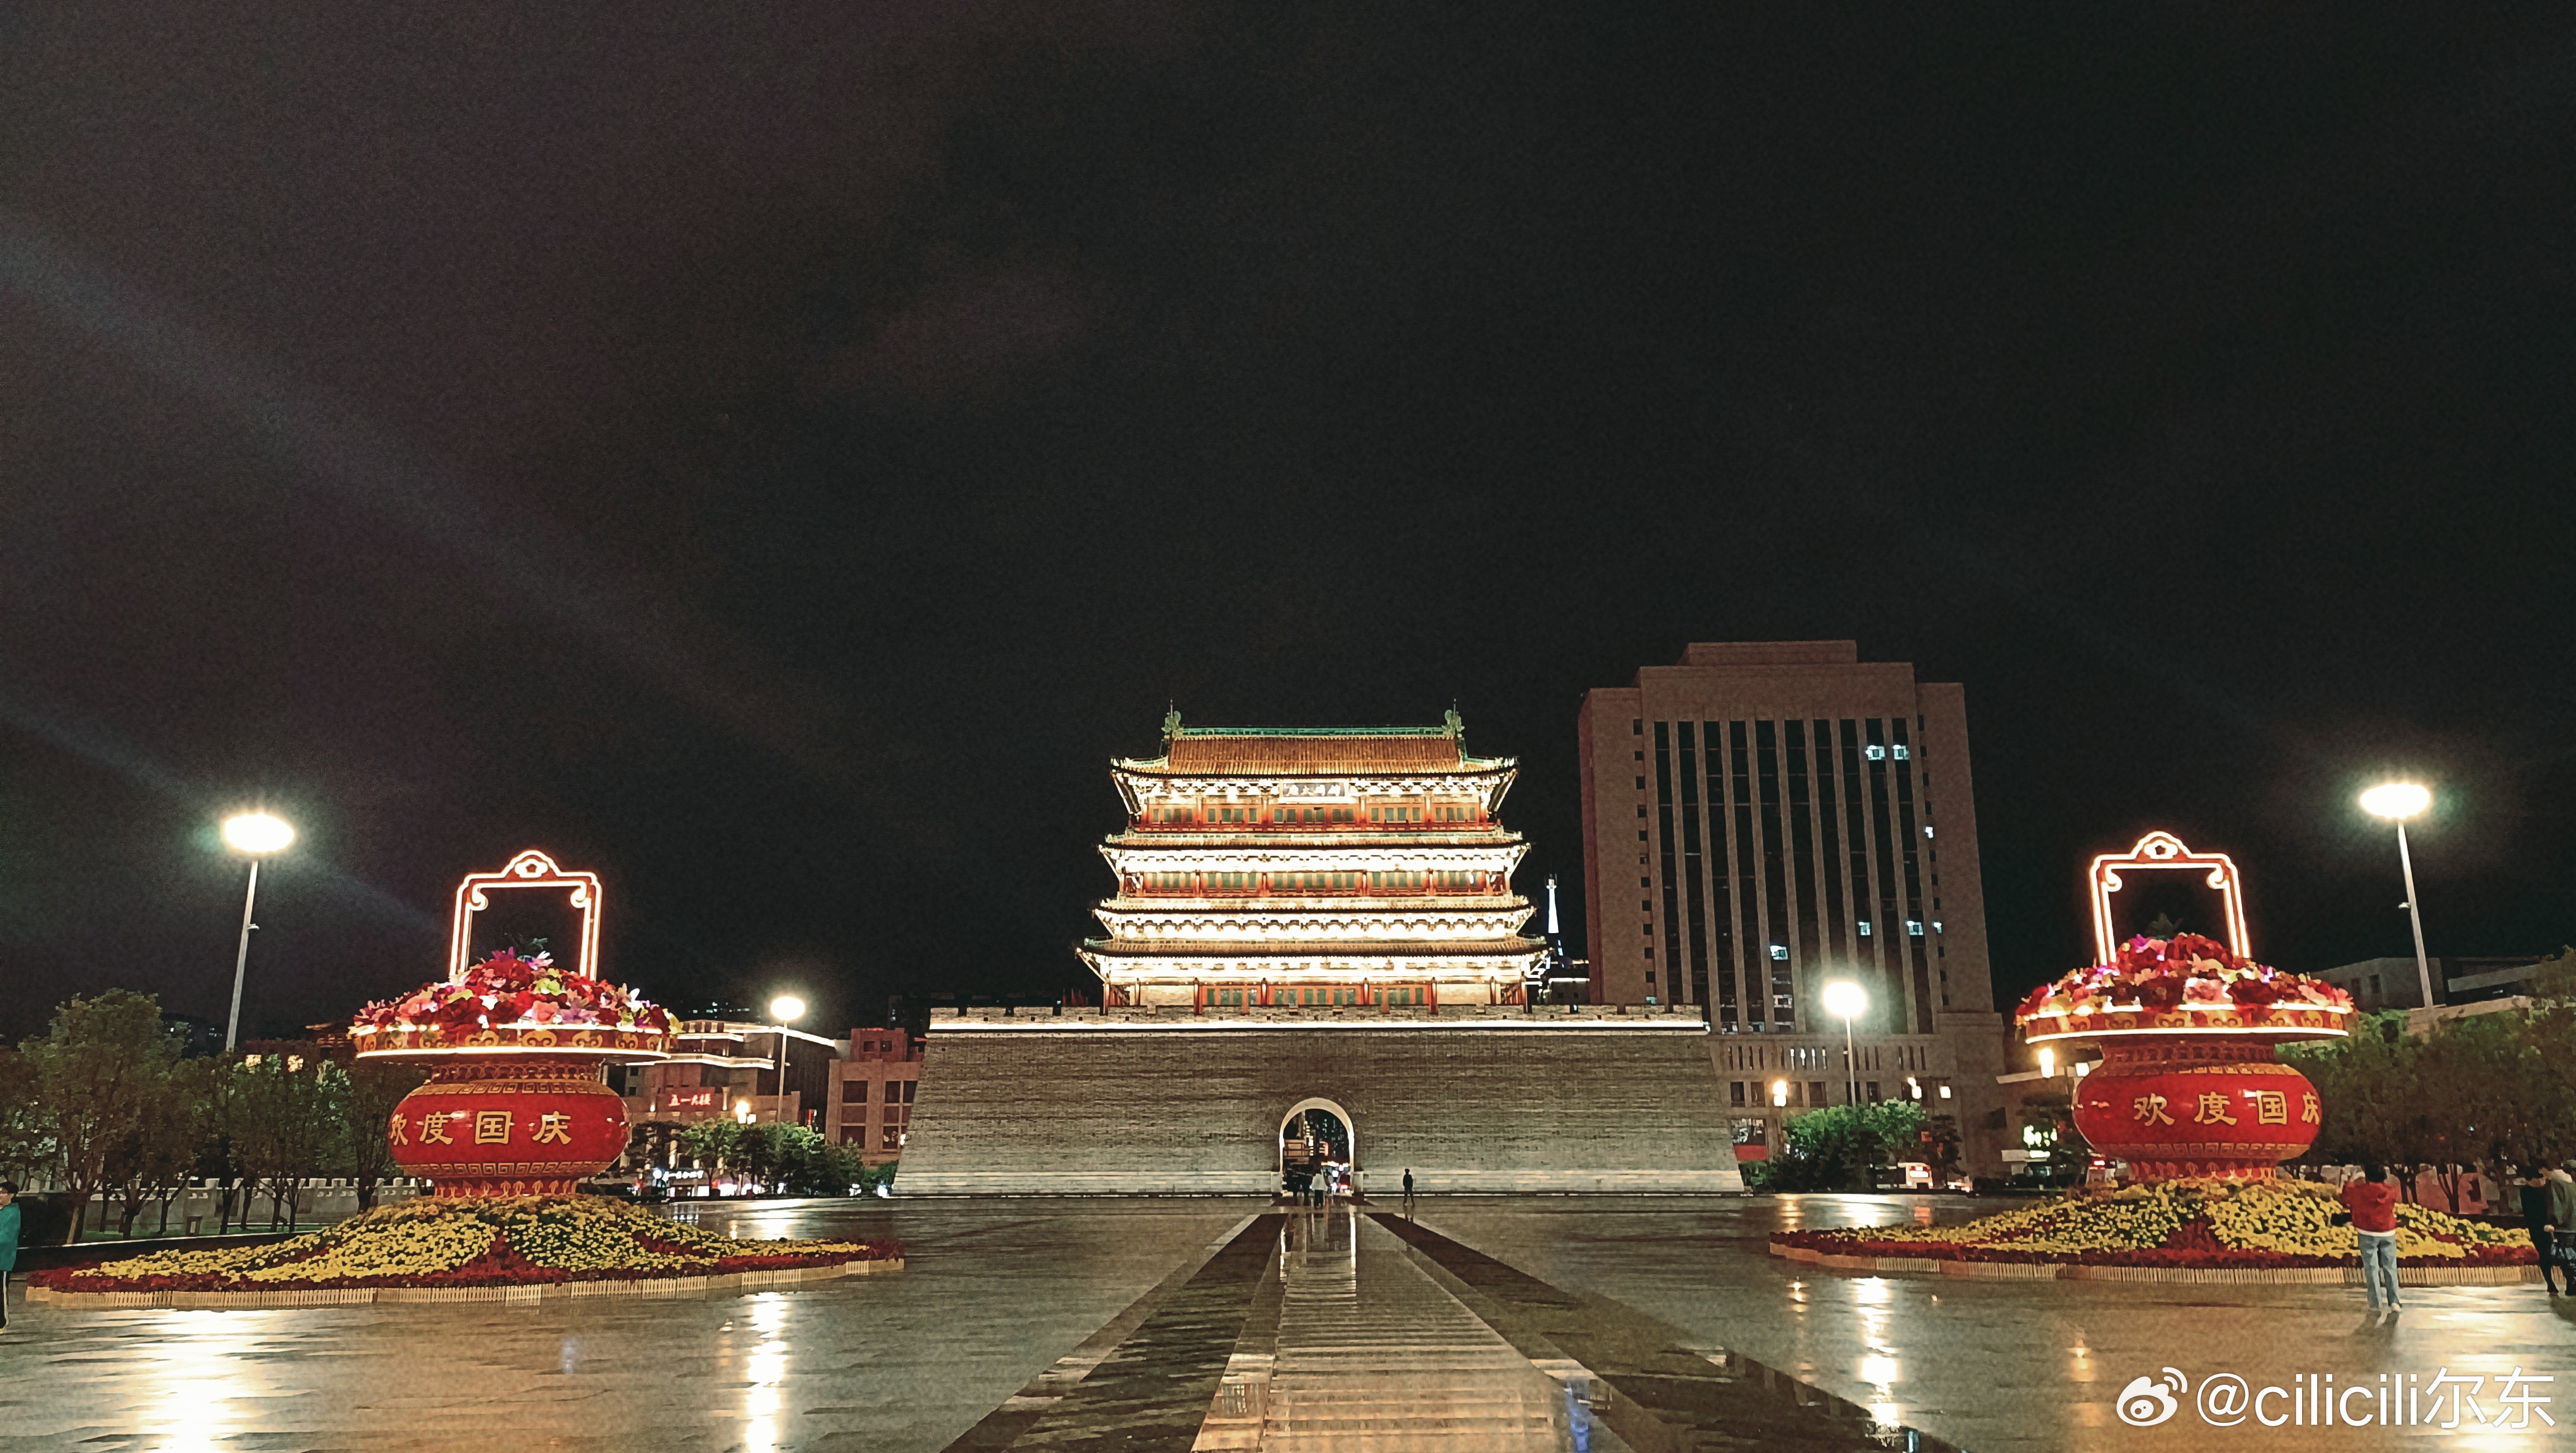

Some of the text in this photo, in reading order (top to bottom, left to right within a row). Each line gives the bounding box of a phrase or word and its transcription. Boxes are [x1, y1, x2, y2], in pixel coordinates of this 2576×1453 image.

[2133, 1090, 2320, 1127] 欢度国庆
[390, 1110, 572, 1146] 欢度国庆
